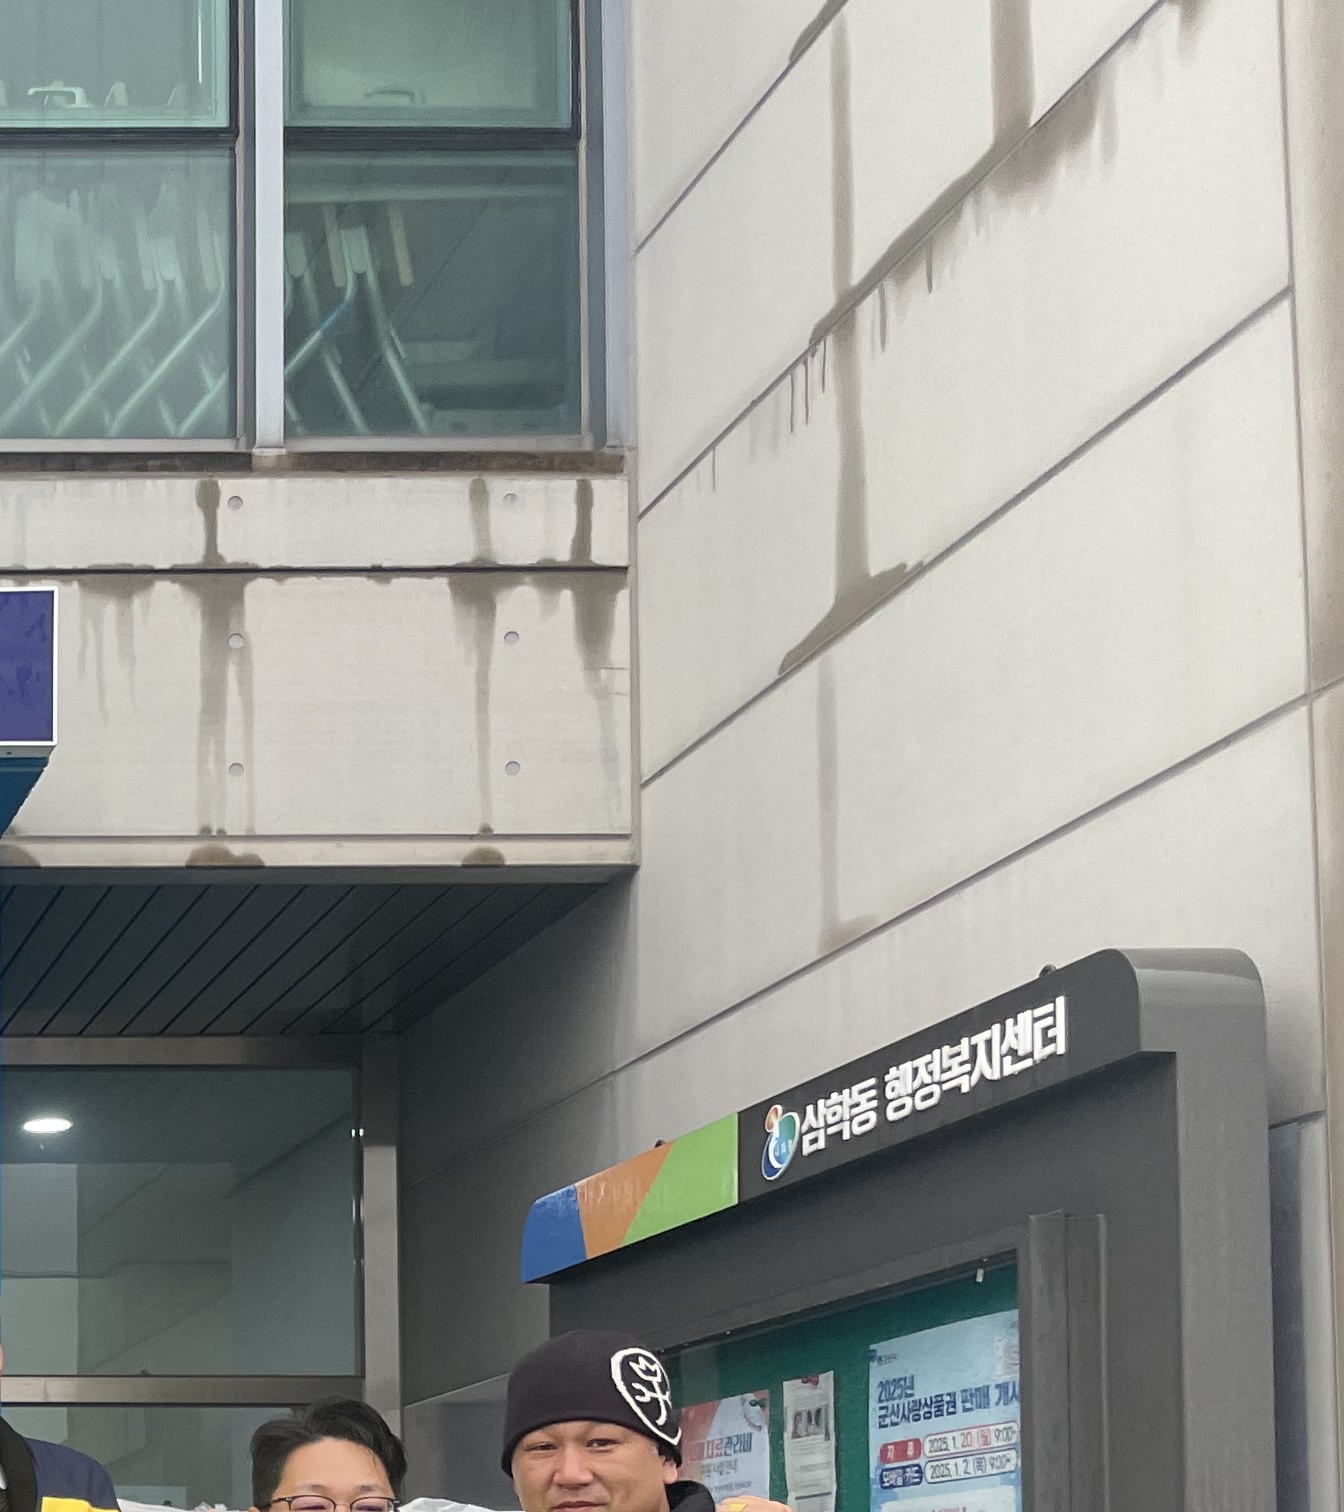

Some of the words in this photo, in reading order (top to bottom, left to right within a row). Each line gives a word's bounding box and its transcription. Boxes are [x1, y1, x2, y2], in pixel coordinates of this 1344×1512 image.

[801, 1077, 877, 1157] 삼학동
[884, 995, 1066, 1122] 행정복지센터
[878, 1391, 957, 1429] 군산사랑상품권
